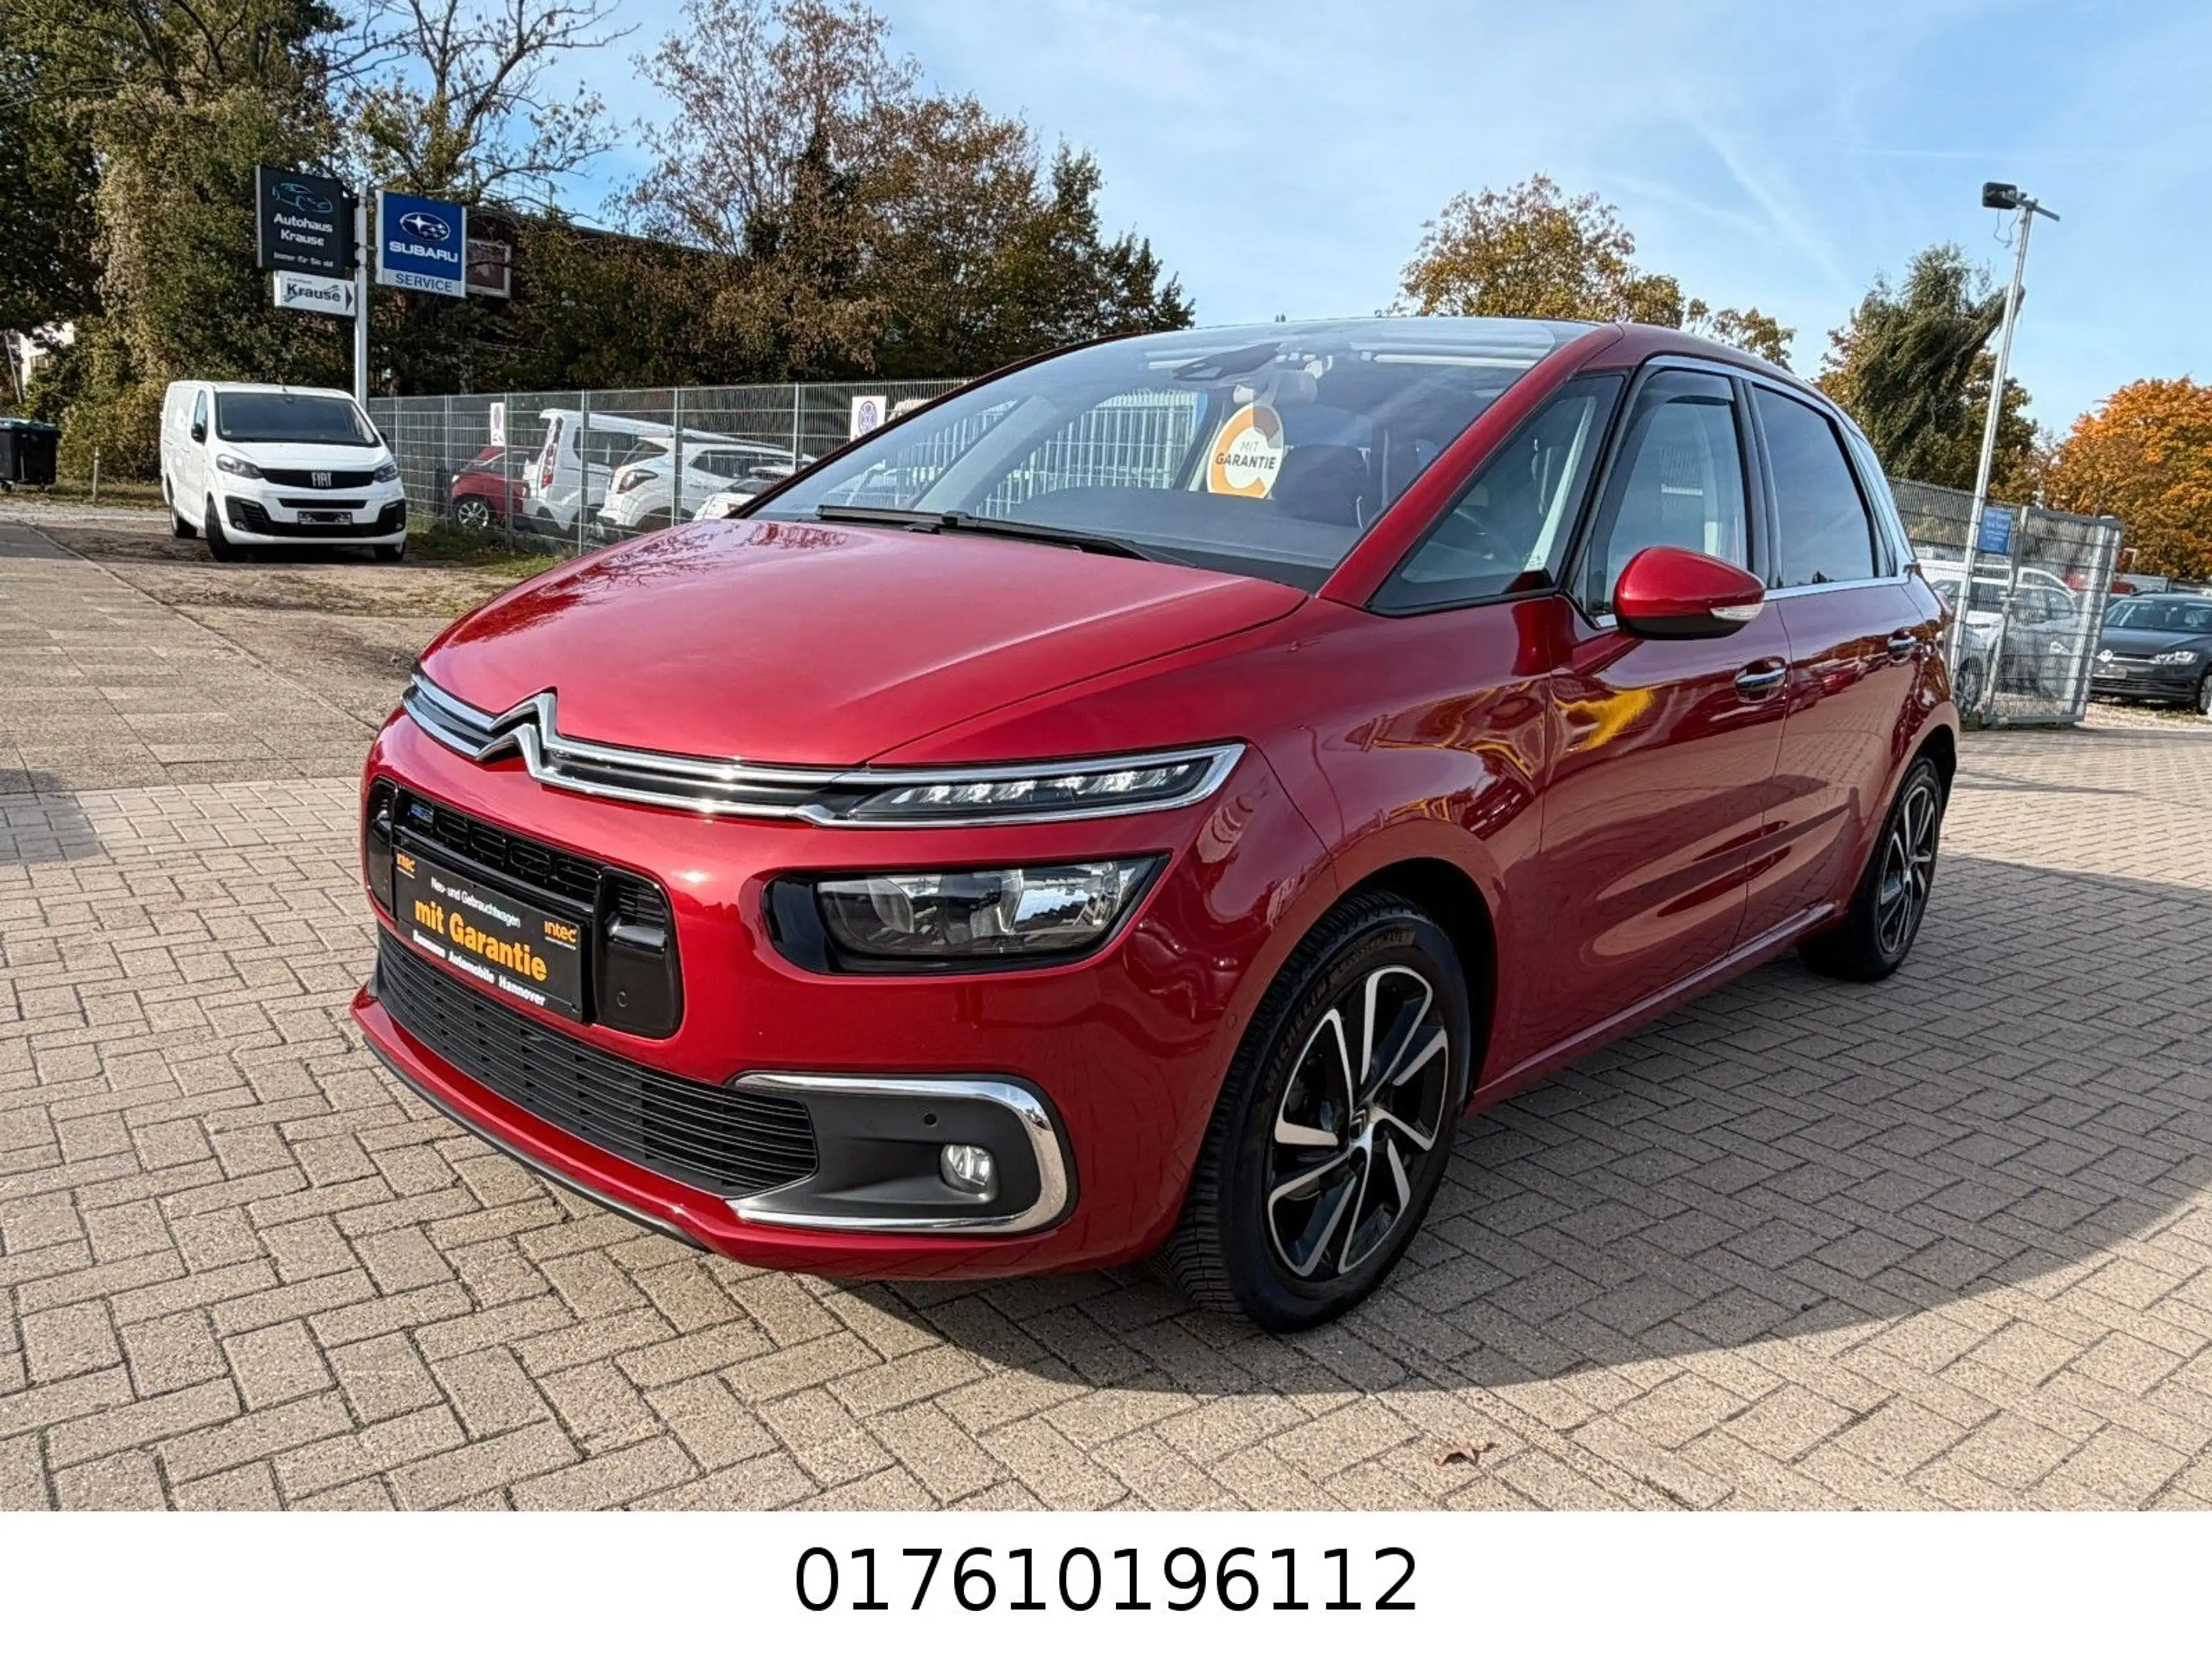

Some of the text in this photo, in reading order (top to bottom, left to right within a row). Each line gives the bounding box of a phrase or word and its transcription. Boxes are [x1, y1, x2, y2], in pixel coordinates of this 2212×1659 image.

[274, 213, 333, 233] Autohaus
[281, 229, 324, 247] Krause
[389, 241, 459, 263] SUBARU
[396, 273, 452, 292] SERVICE
[287, 283, 341, 302] Krause
[1240, 441, 1259, 452] MIT
[1216, 452, 1277, 469] GARANTIE
[312, 472, 332, 487] FIAT
[415, 900, 444, 934] mit
[449, 912, 547, 980] Garantie
[499, 975, 546, 1006] Hannover
